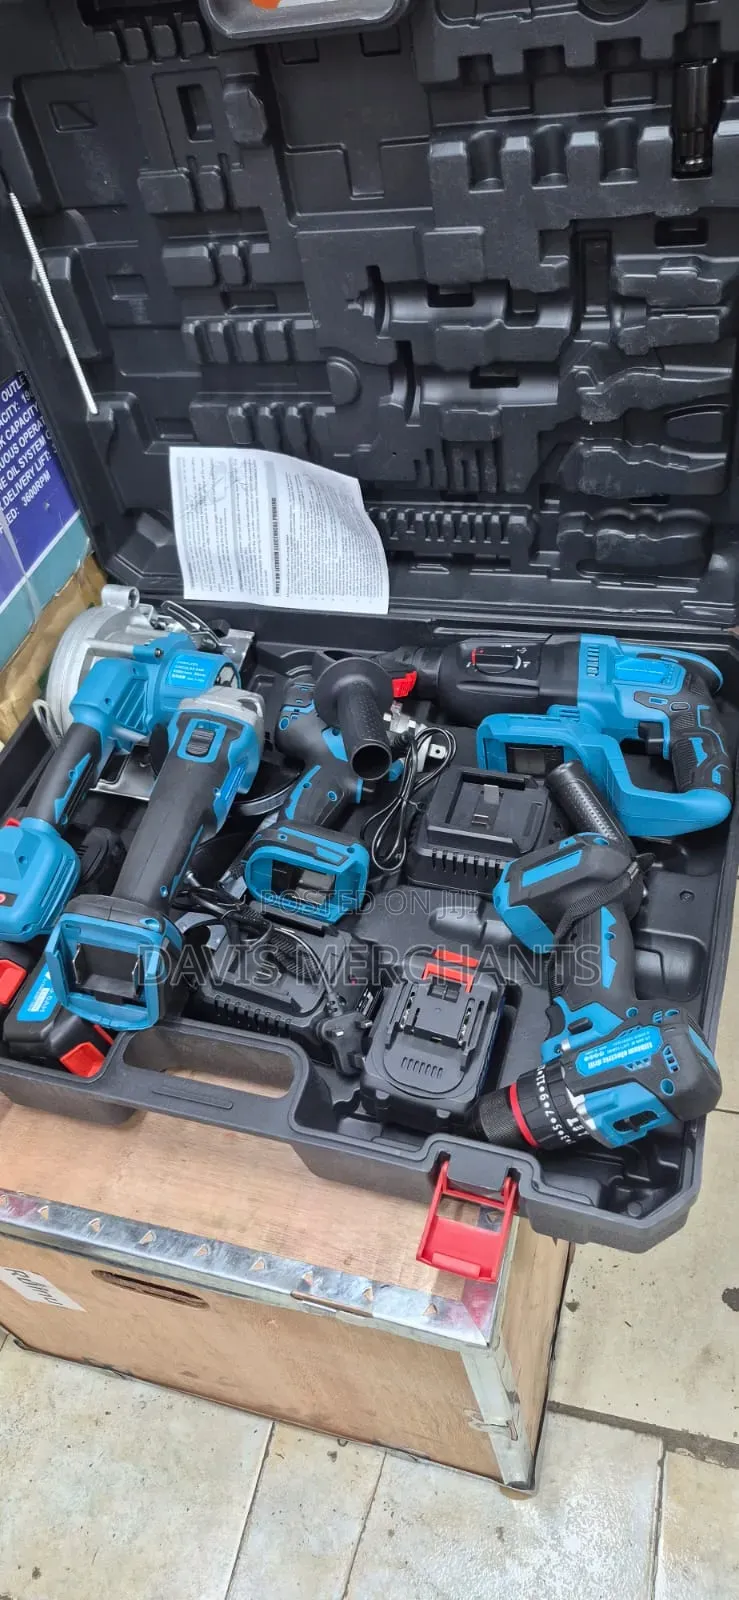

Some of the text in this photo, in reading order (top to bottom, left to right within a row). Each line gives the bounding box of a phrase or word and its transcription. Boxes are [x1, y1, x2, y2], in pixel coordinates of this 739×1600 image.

[6, 465, 20, 481] OIL
[18, 435, 47, 468] SYSTEM
[34, 450, 52, 472] LIFT:
[21, 469, 51, 507] 3600RPM
